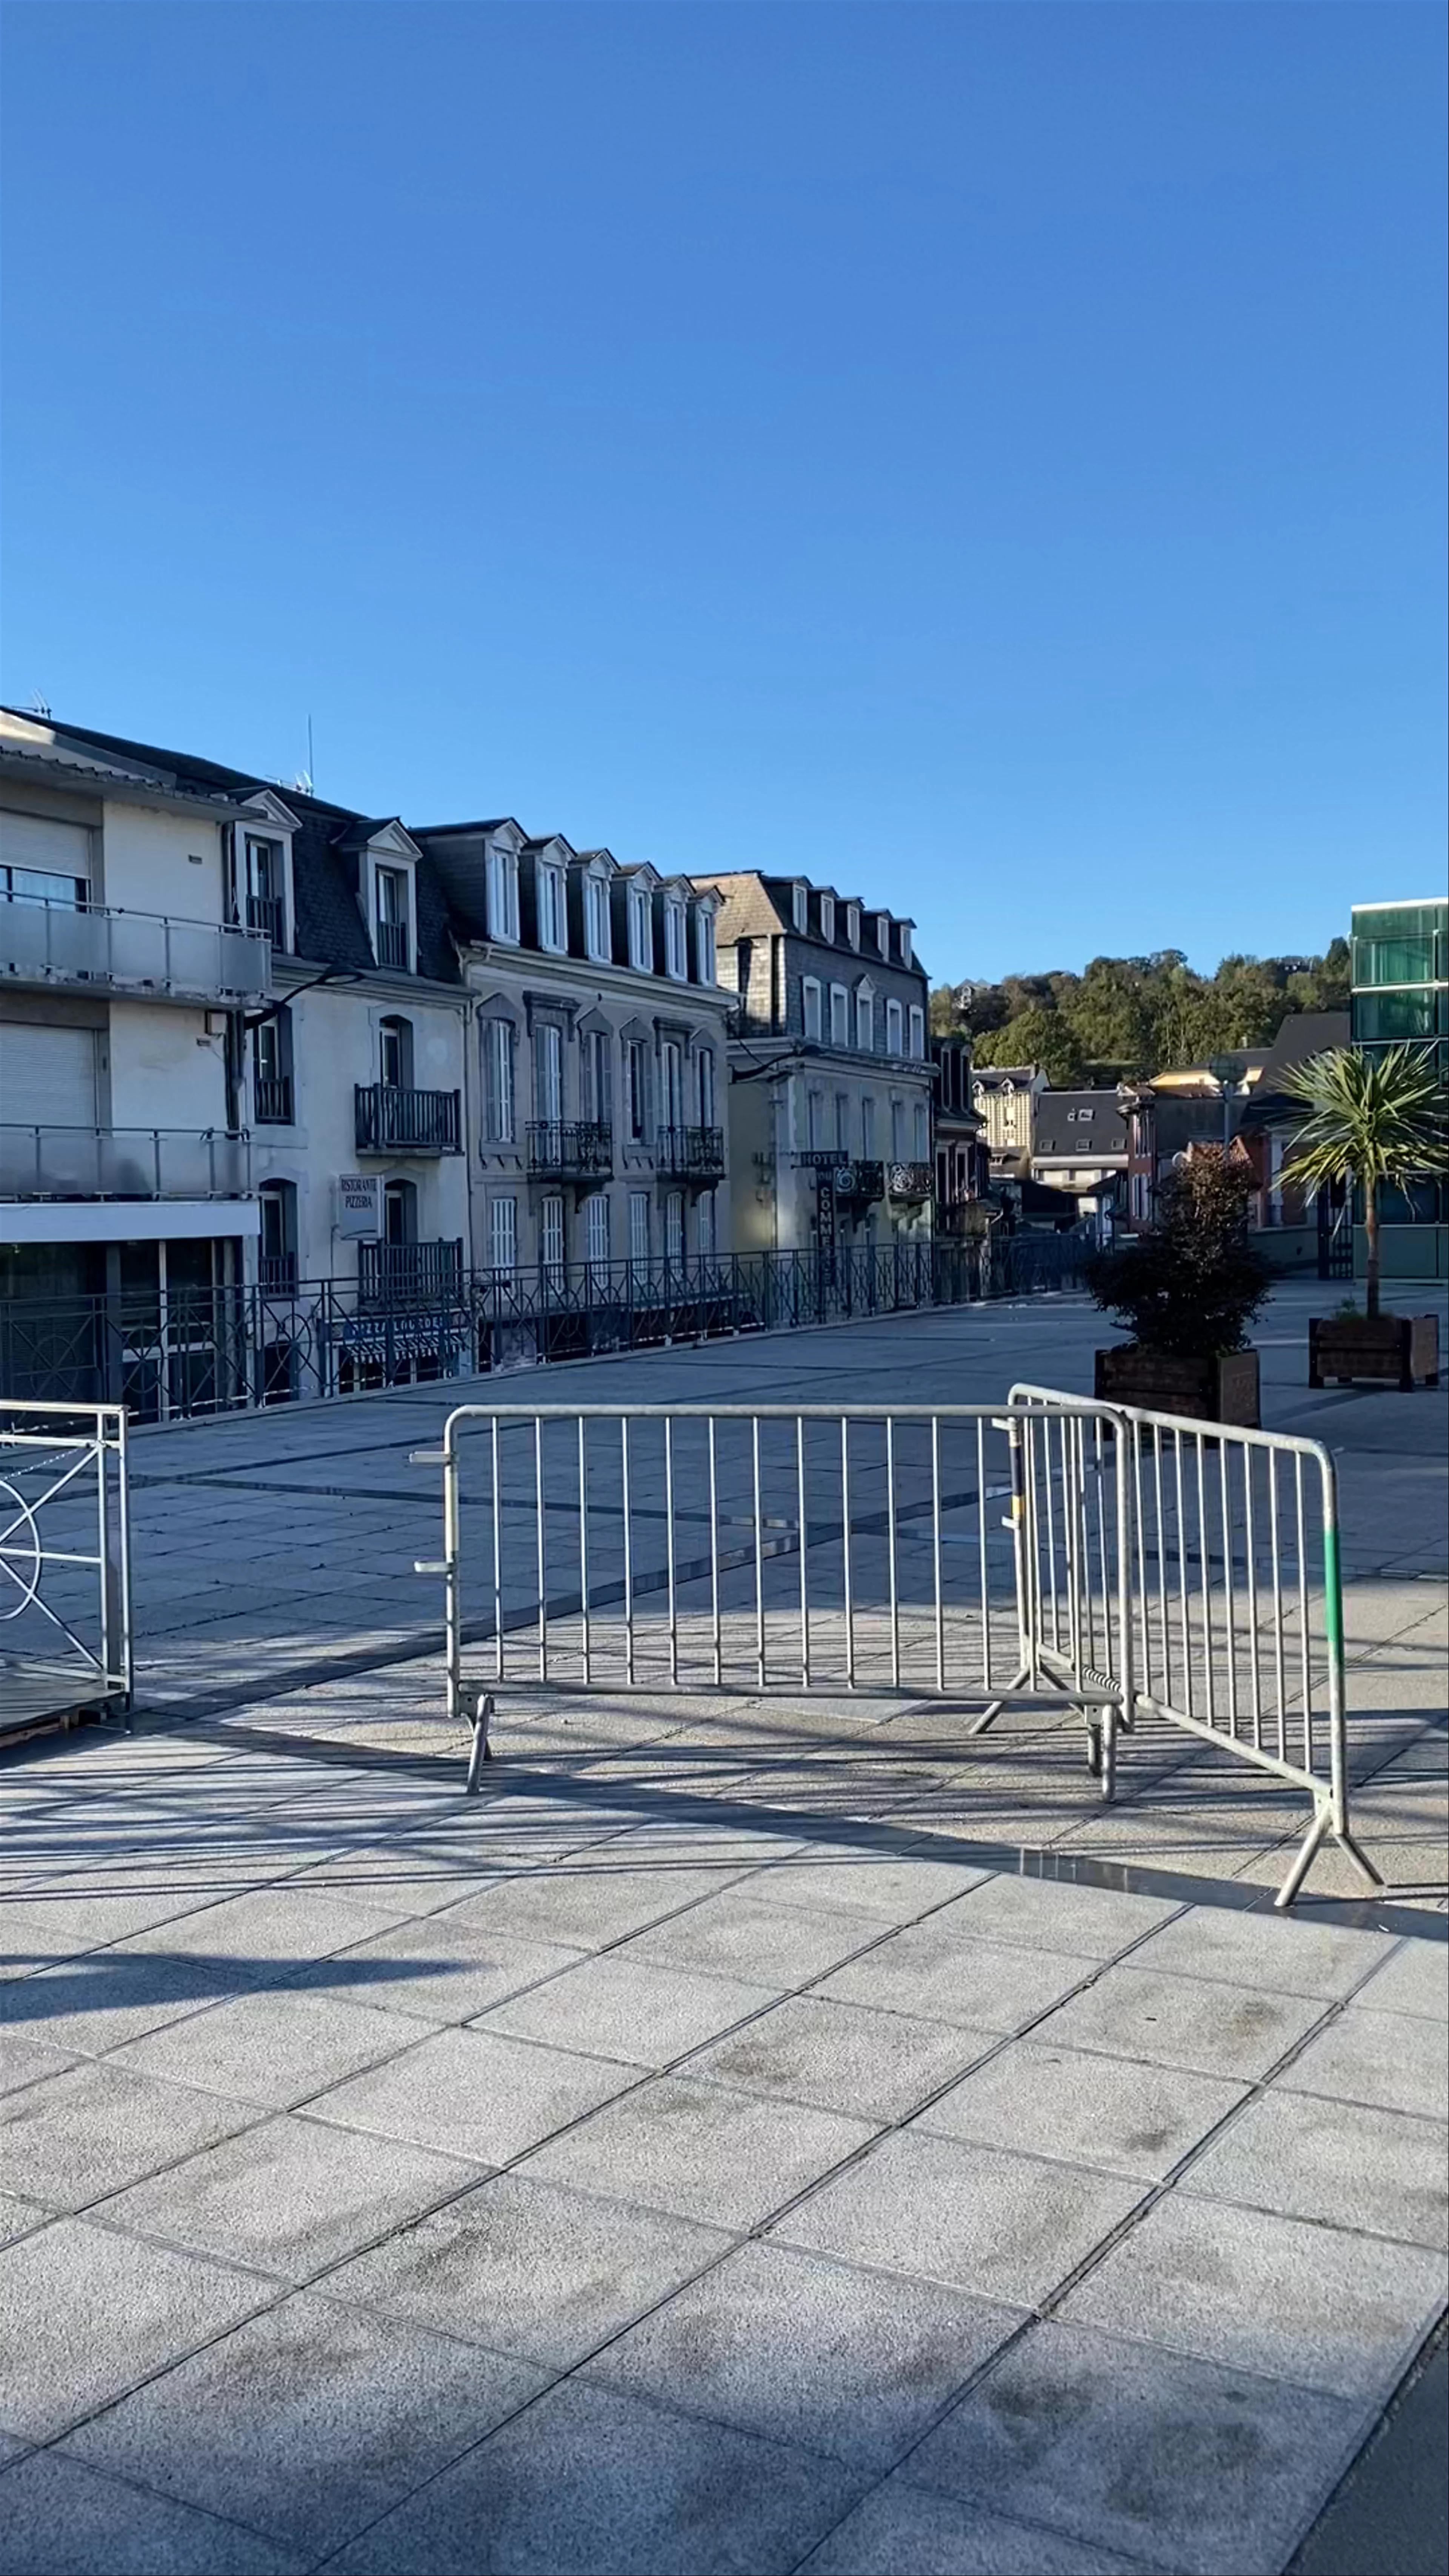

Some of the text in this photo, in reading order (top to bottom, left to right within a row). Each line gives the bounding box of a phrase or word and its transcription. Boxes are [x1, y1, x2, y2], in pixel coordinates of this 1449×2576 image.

[803, 1153, 847, 1165] HOTEL
[341, 1178, 377, 1192] RISTORANTE
[345, 1195, 372, 1208] PIZZERIA
